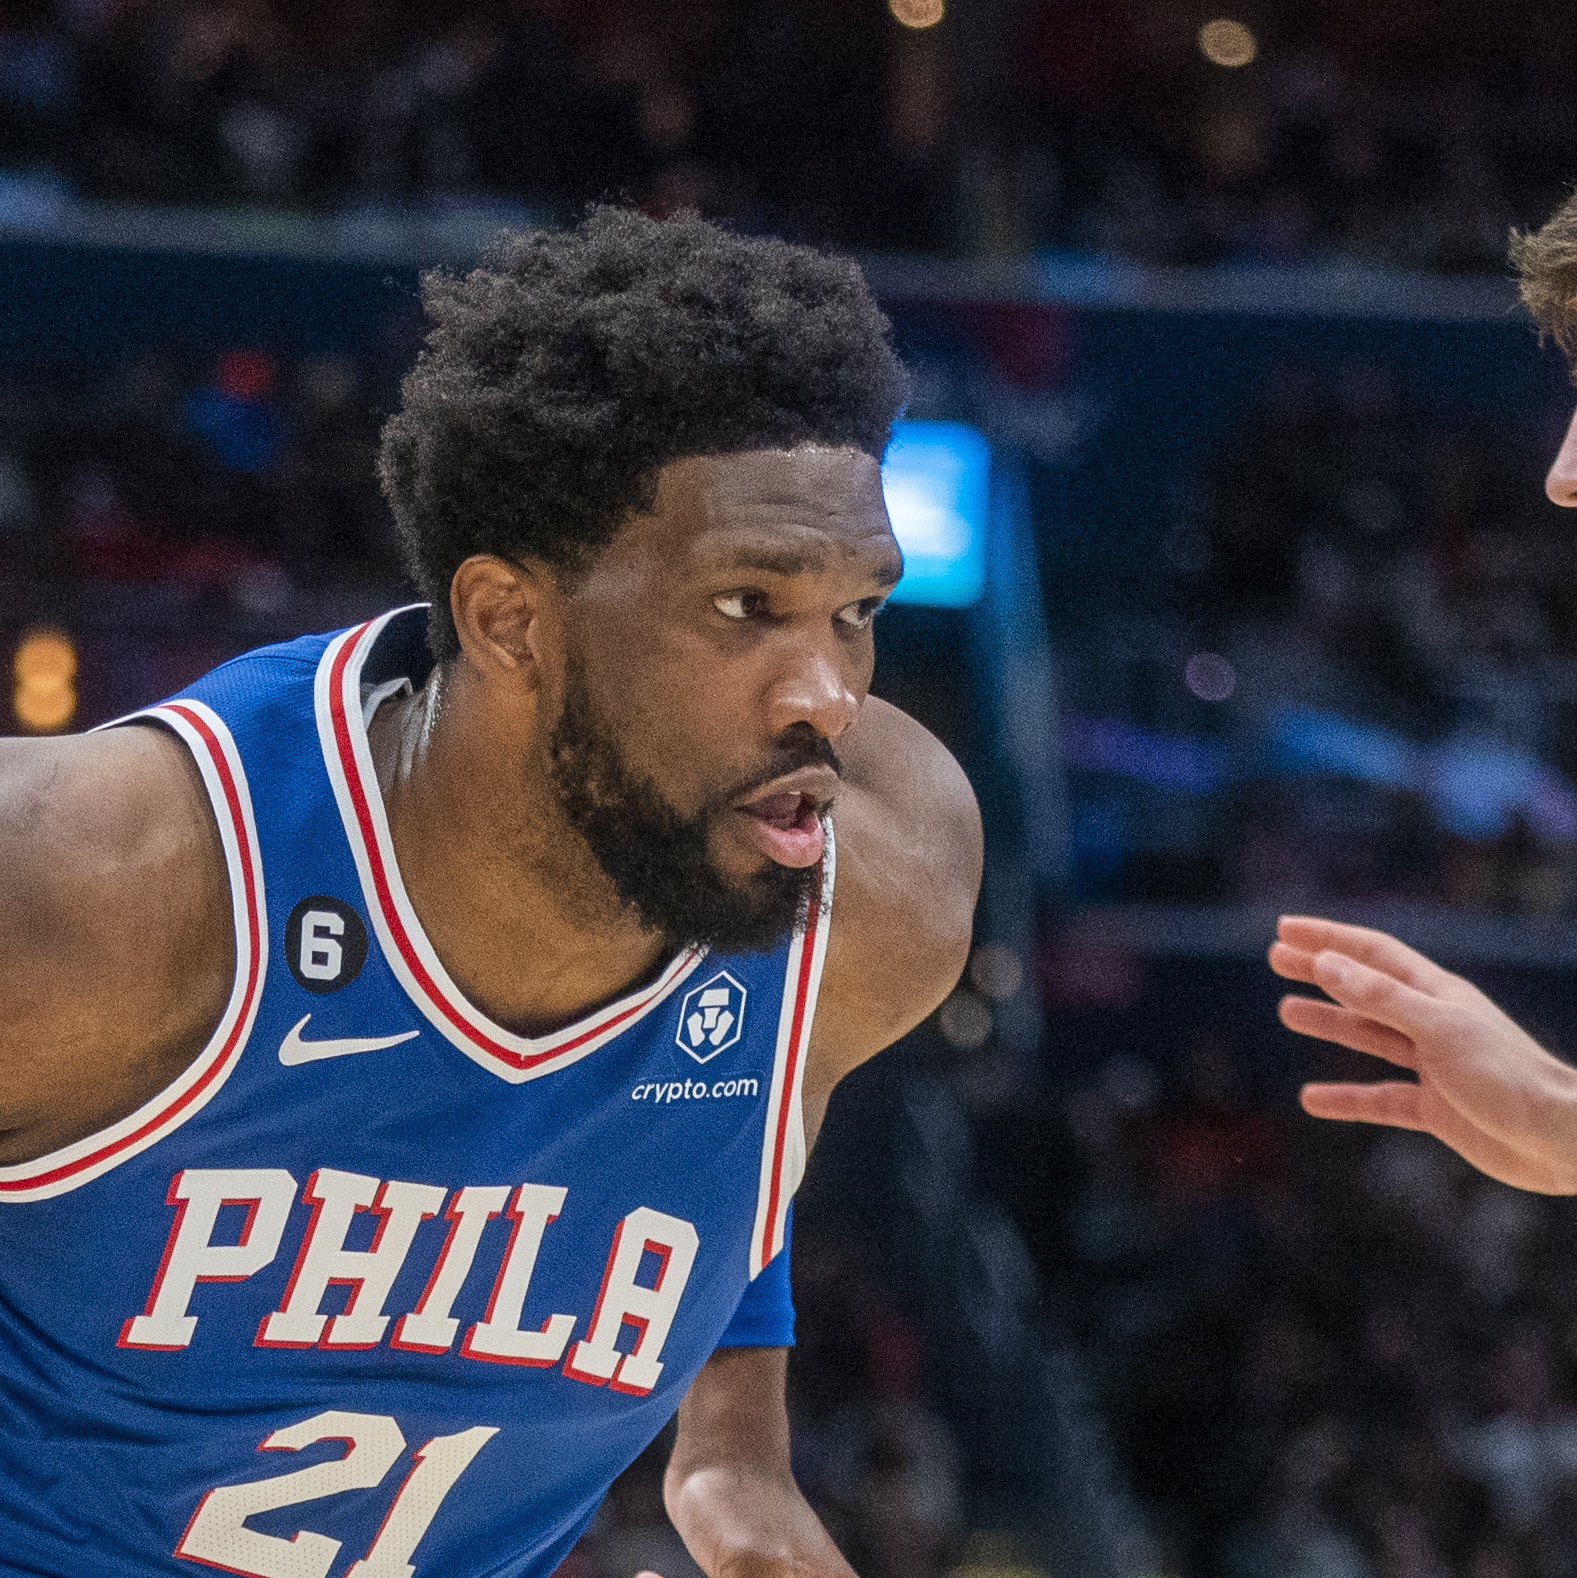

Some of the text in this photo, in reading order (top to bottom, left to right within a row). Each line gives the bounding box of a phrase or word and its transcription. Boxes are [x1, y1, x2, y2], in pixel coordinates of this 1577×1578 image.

[299, 910, 347, 980] 6
[630, 1072, 759, 1105] crypto.com
[115, 1167, 701, 1397] PHILA
